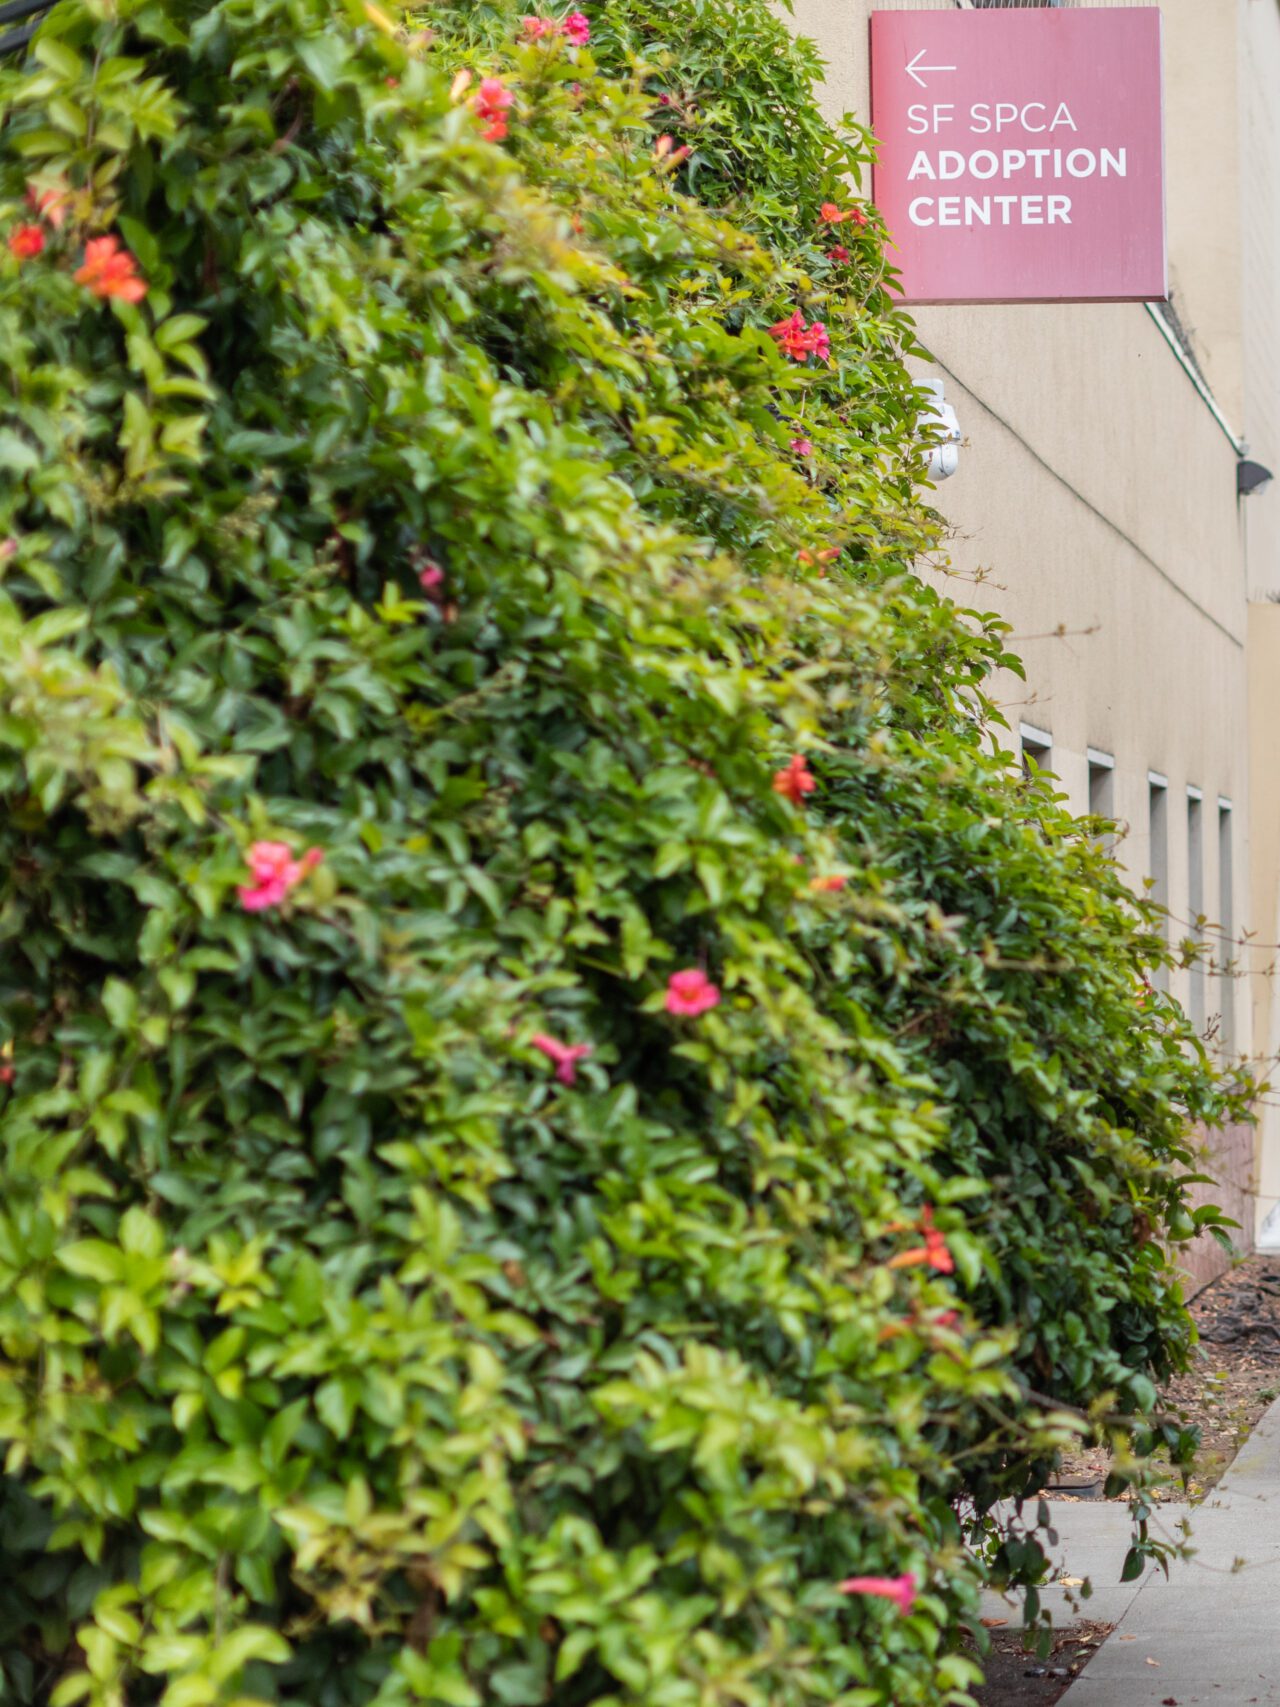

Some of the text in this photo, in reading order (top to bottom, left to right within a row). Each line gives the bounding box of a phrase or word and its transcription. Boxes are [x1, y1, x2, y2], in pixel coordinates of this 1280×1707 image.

[907, 102, 1078, 134] SF SPCA
[907, 148, 1127, 180] ADOPTION
[908, 195, 1072, 227] CENTER
